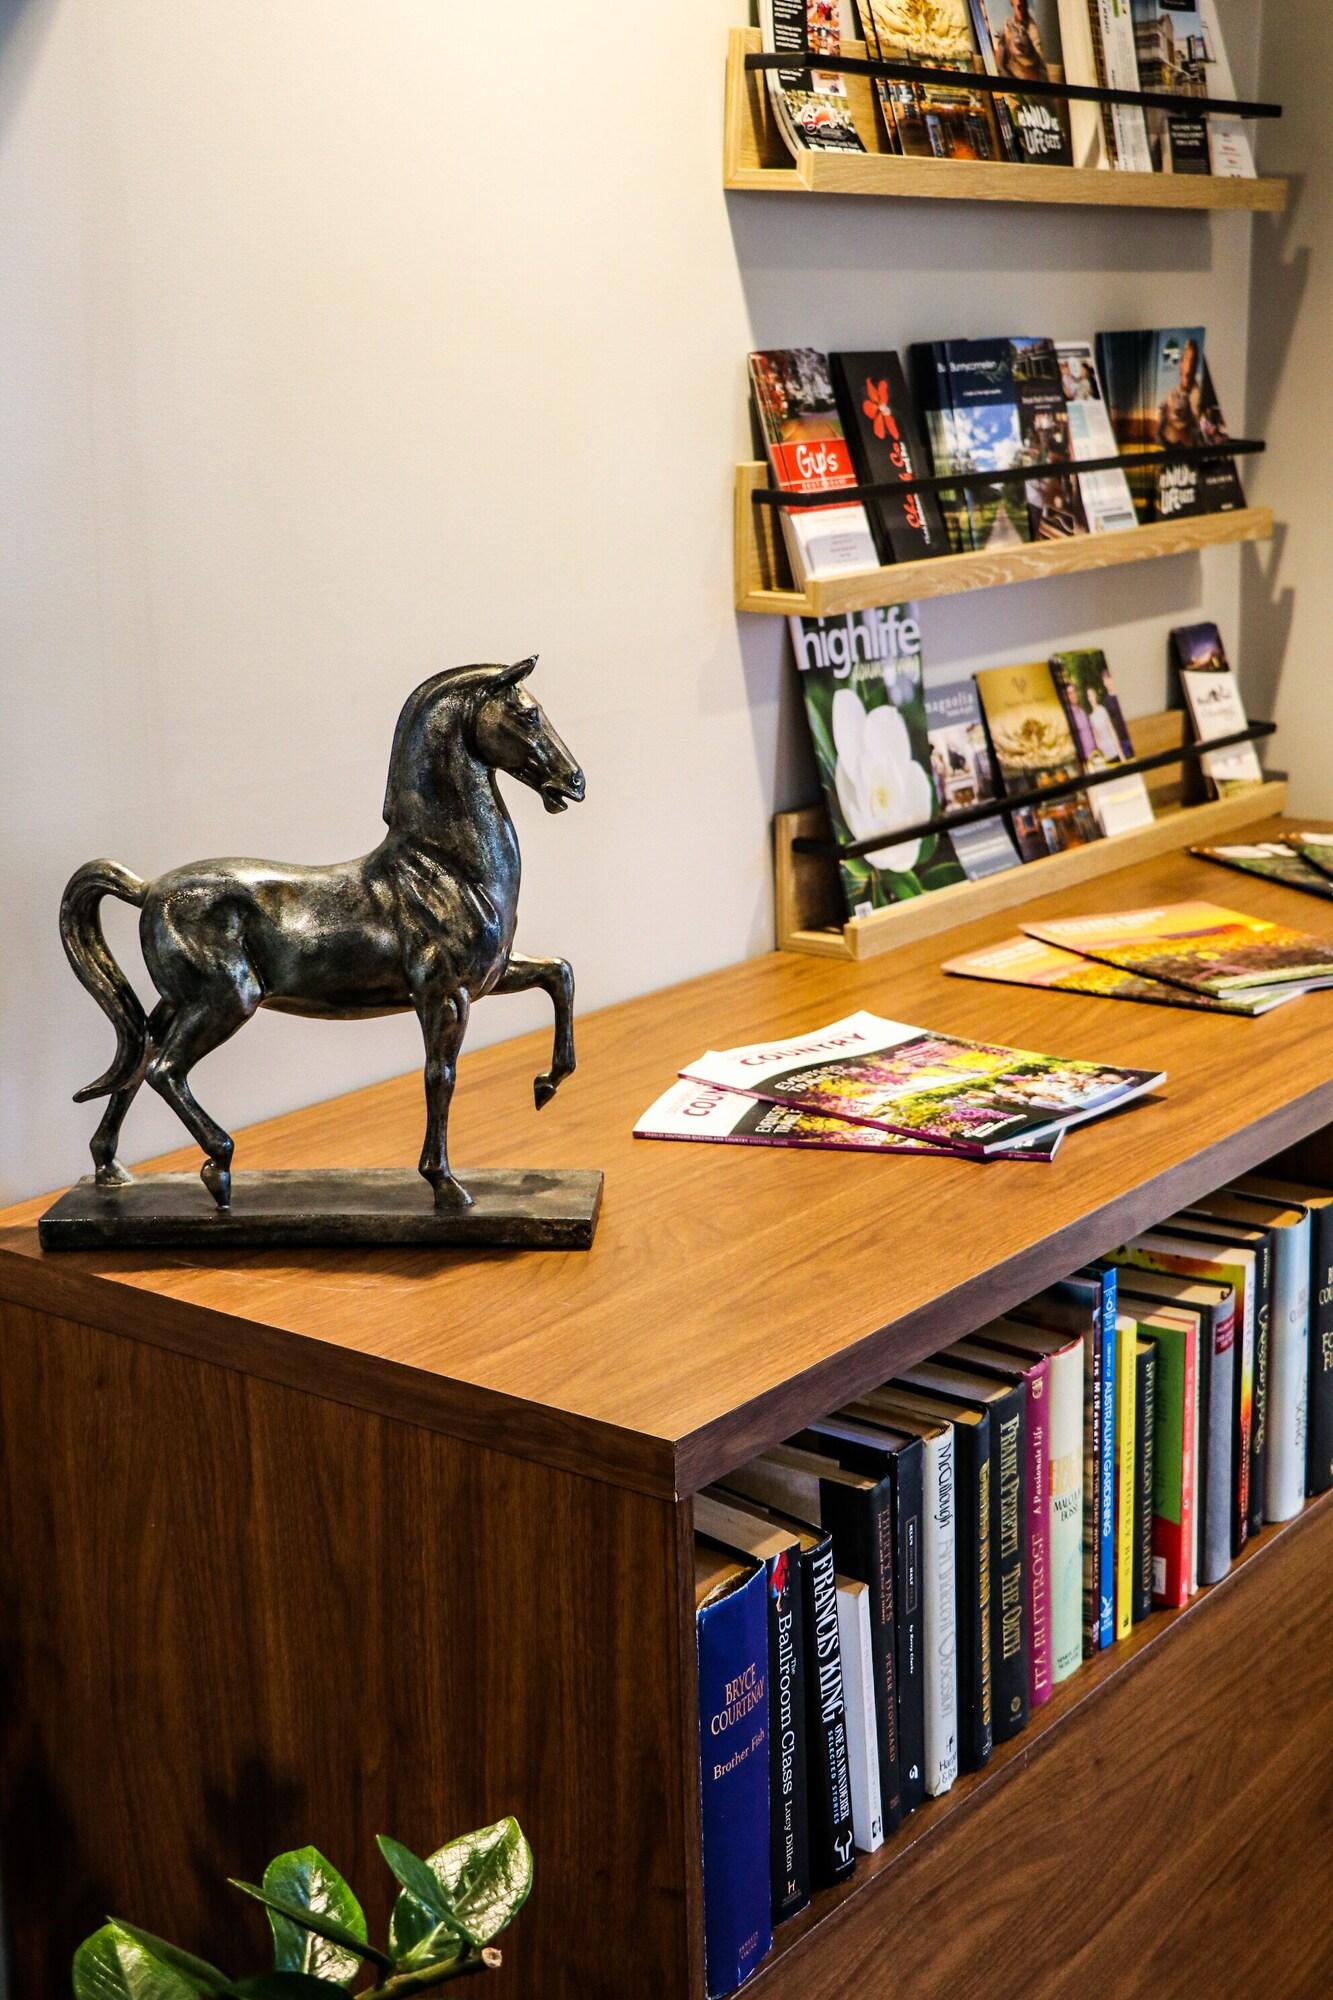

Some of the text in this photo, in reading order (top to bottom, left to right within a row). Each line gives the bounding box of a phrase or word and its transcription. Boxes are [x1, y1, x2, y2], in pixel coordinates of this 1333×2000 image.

[788, 604, 921, 680] highlife
[740, 1033, 867, 1067] COUNTRY
[1000, 1412, 1019, 1486] FRANK
[1104, 1381, 1113, 1458] AUSTRALIAN
[1033, 1426, 1042, 1515] A Passionate Life
[1103, 1459, 1112, 1537] GARDENING
[881, 1504, 894, 1623] THIRTY DAYS
[1002, 1561, 1022, 1611] THE
[812, 1549, 844, 1724] FRANCIS KING
[1003, 1605, 1022, 1661] OATH
[1032, 1531, 1047, 1691] ITA BUTTROSE
[710, 1676, 765, 1735] COURTENAY
[725, 1662, 756, 1706] BRYCE
[885, 1652, 896, 1763] PETER STOTHARD
[713, 1728, 765, 1780] Brother Fish
[778, 1610, 795, 1872] Ballroom Class Lucy Dillon
[834, 1722, 844, 1746] ONE
[836, 1744, 846, 1758] IS
[827, 1730, 840, 1824] SELECTED STORIES
[838, 1765, 850, 1821] WANDERER
